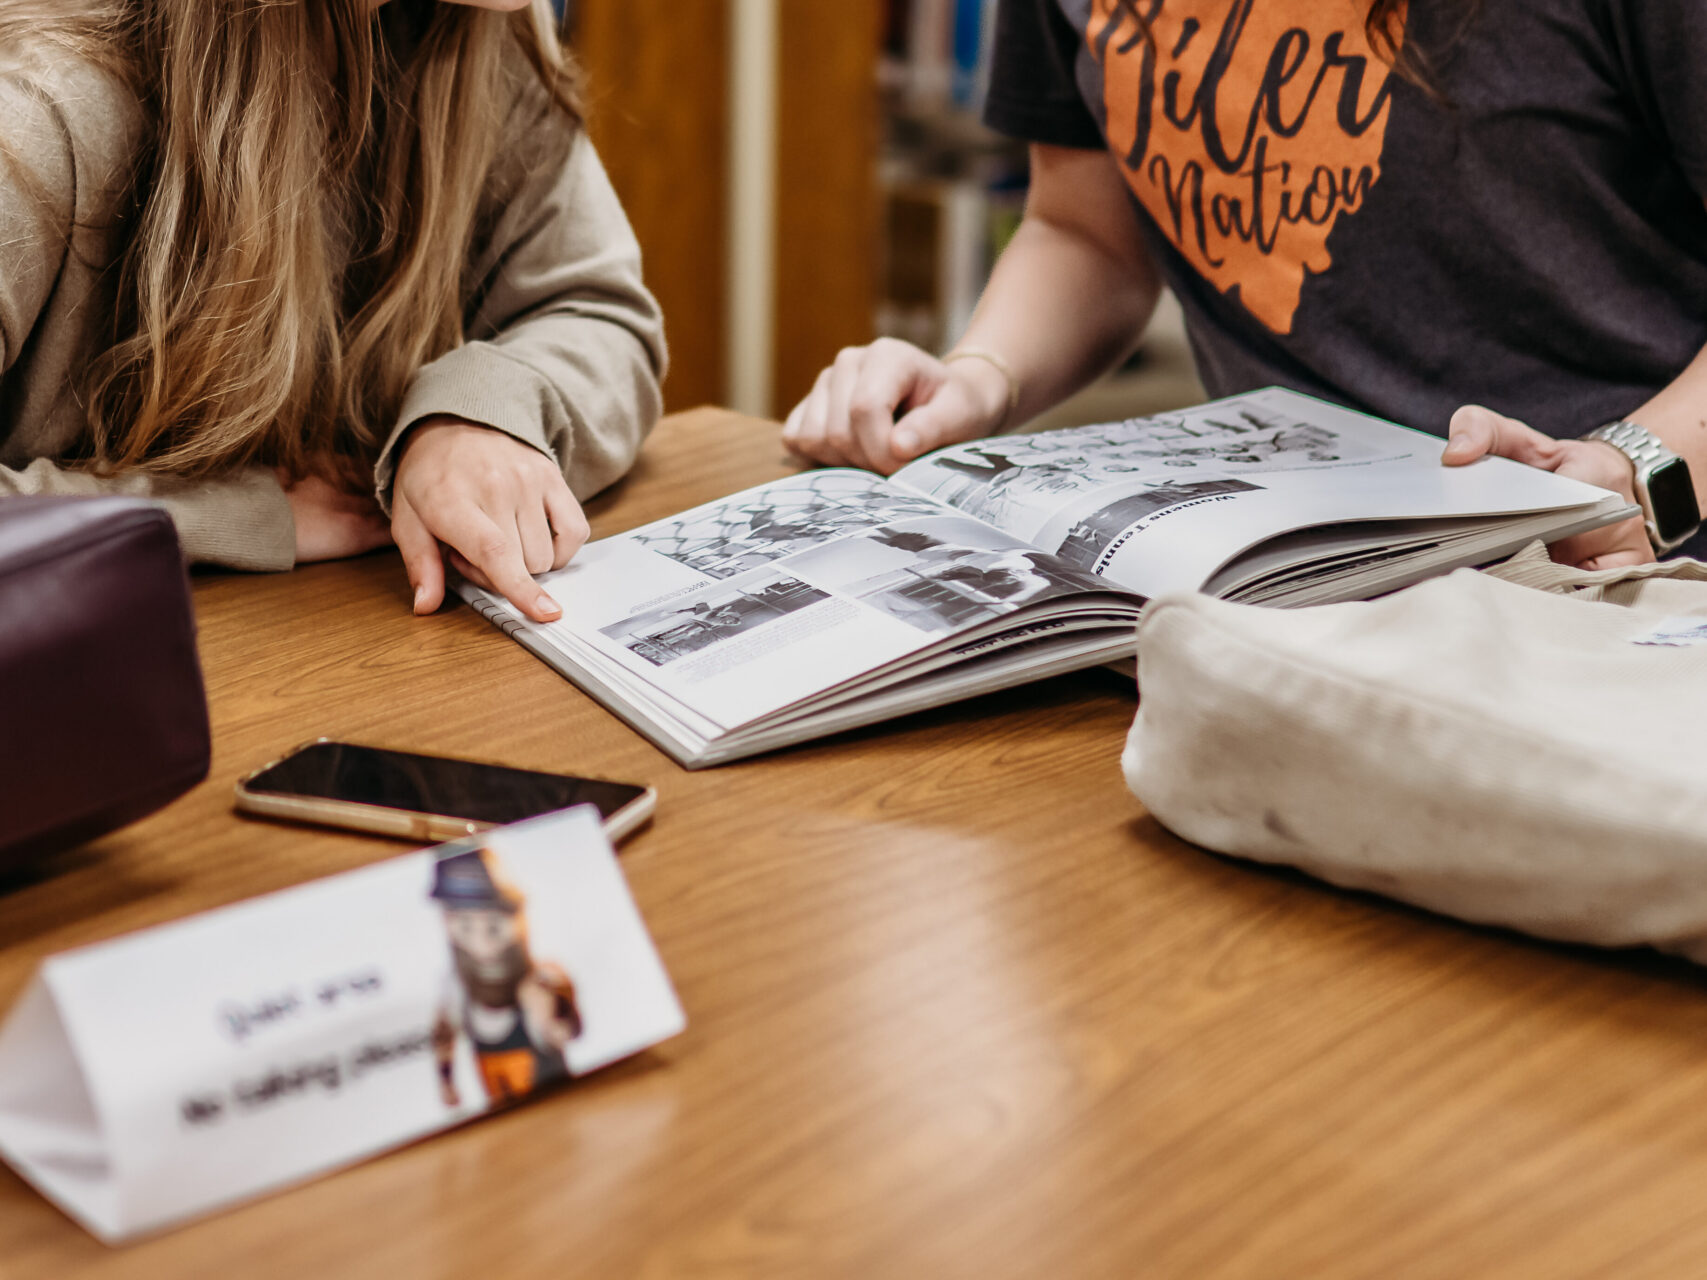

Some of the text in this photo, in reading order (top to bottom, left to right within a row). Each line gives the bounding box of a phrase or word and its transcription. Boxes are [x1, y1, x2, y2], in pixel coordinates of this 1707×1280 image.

[1148, 135, 1374, 268] Nation
[1095, 495, 1237, 576] Womens Tennis
